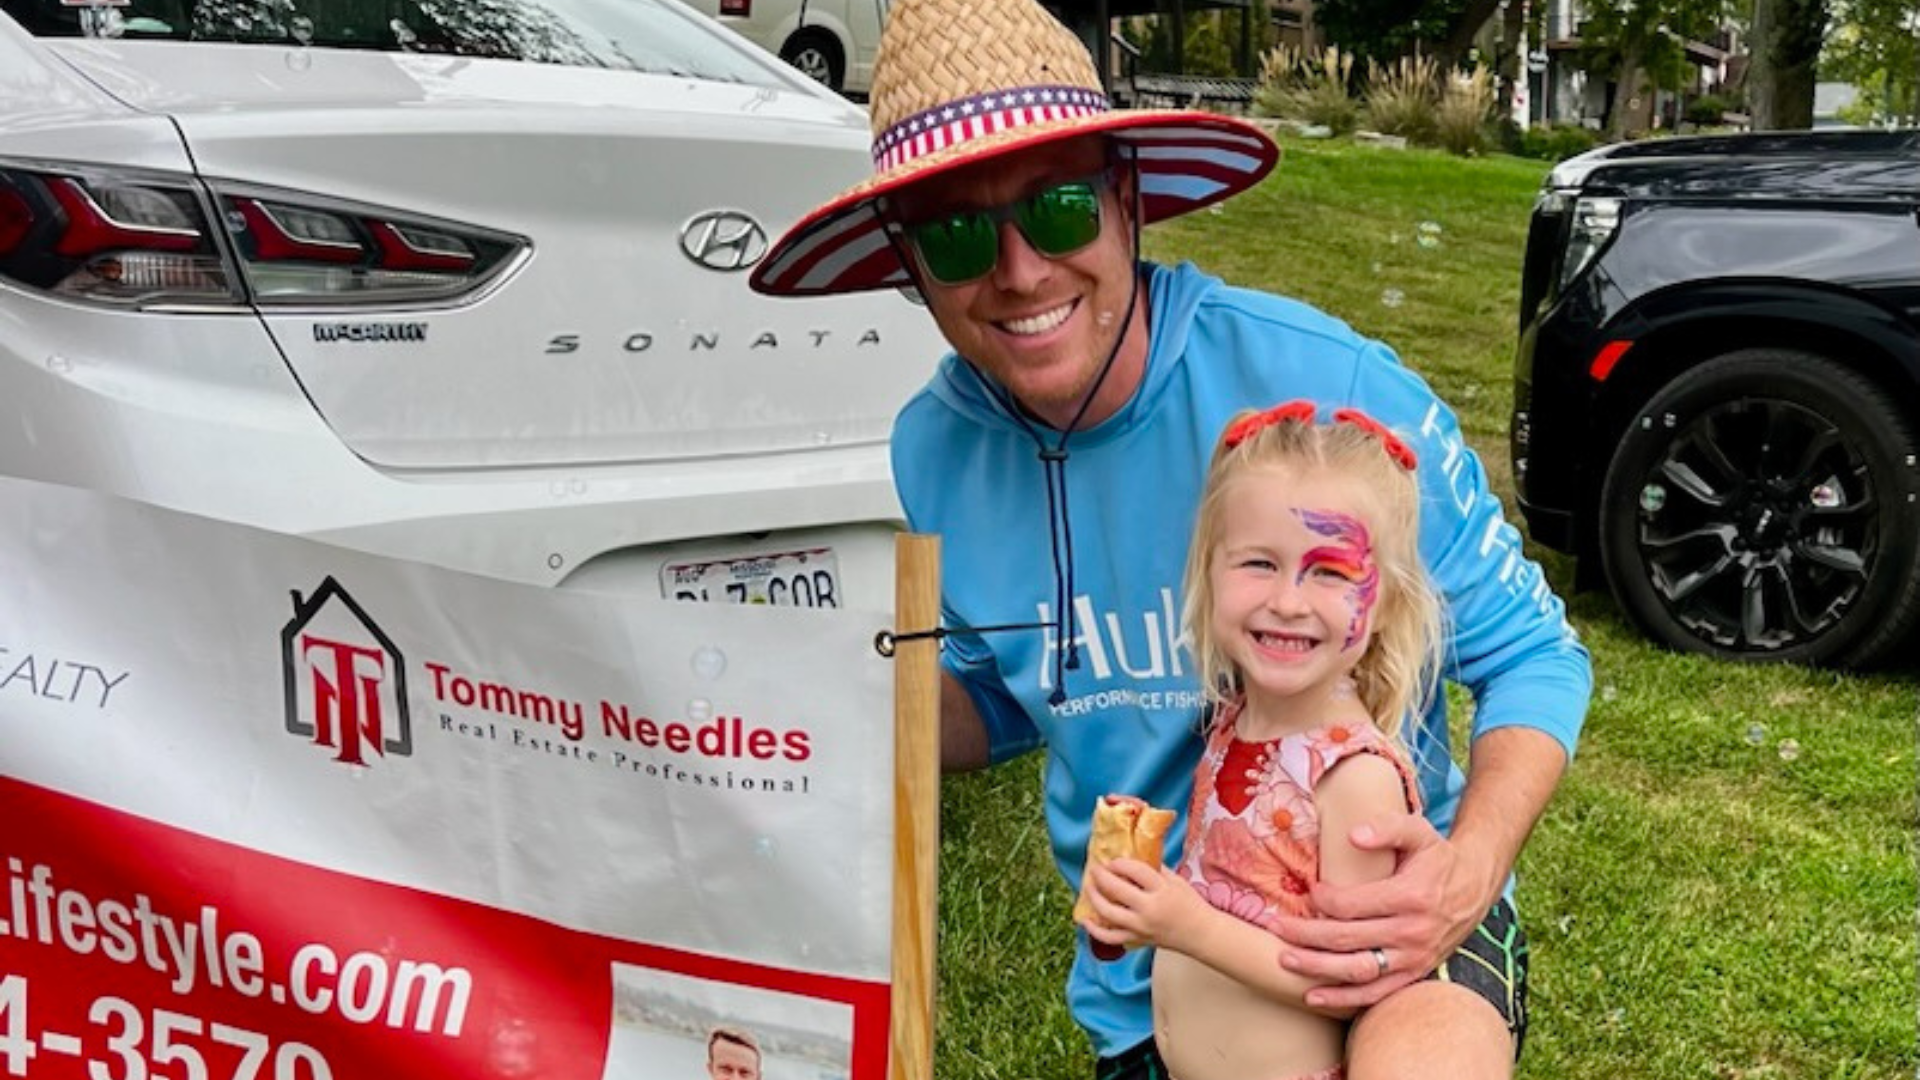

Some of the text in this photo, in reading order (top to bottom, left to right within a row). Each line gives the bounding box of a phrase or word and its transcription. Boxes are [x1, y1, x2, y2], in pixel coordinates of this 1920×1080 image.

[545, 329, 881, 354] SONATA
[0, 647, 130, 708] ALTY
[424, 662, 812, 762] Tommy Needles
[439, 713, 810, 794] Real Estate Professional
[0, 856, 473, 1037] ifestyle.com
